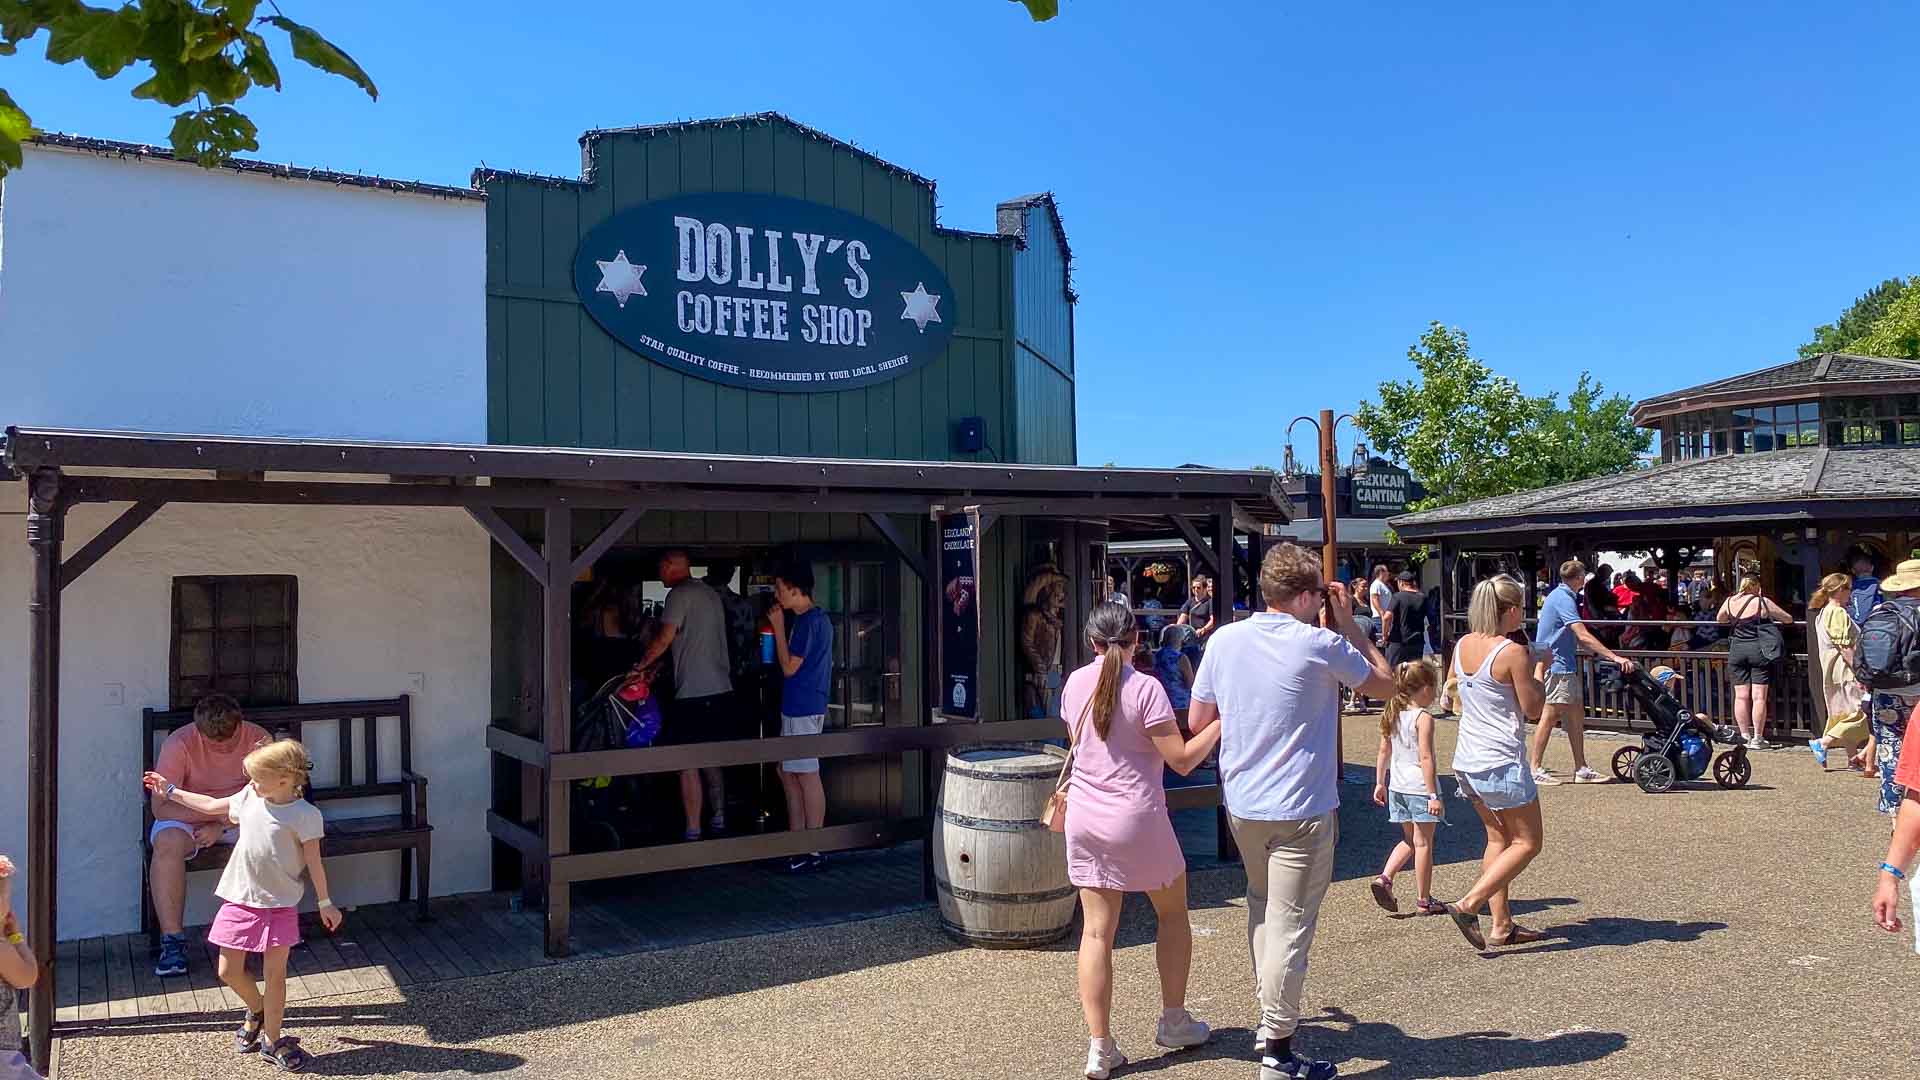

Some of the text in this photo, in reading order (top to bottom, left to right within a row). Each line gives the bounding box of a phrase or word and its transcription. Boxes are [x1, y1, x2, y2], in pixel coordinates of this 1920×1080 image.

[677, 290, 872, 347] COFFEE SHOP
[639, 334, 666, 353] STAR
[666, 346, 705, 366] QUALITY
[707, 359, 739, 375] COFFEE
[749, 368, 812, 382] RECOMMENDED
[814, 372, 826, 381] BY
[827, 370, 851, 381] YOUR
[852, 365, 877, 378] LOCAL
[878, 354, 910, 372] SHERIFF
[1356, 488, 1406, 503] CANTINA
[943, 527, 971, 538] LEGOLAND
